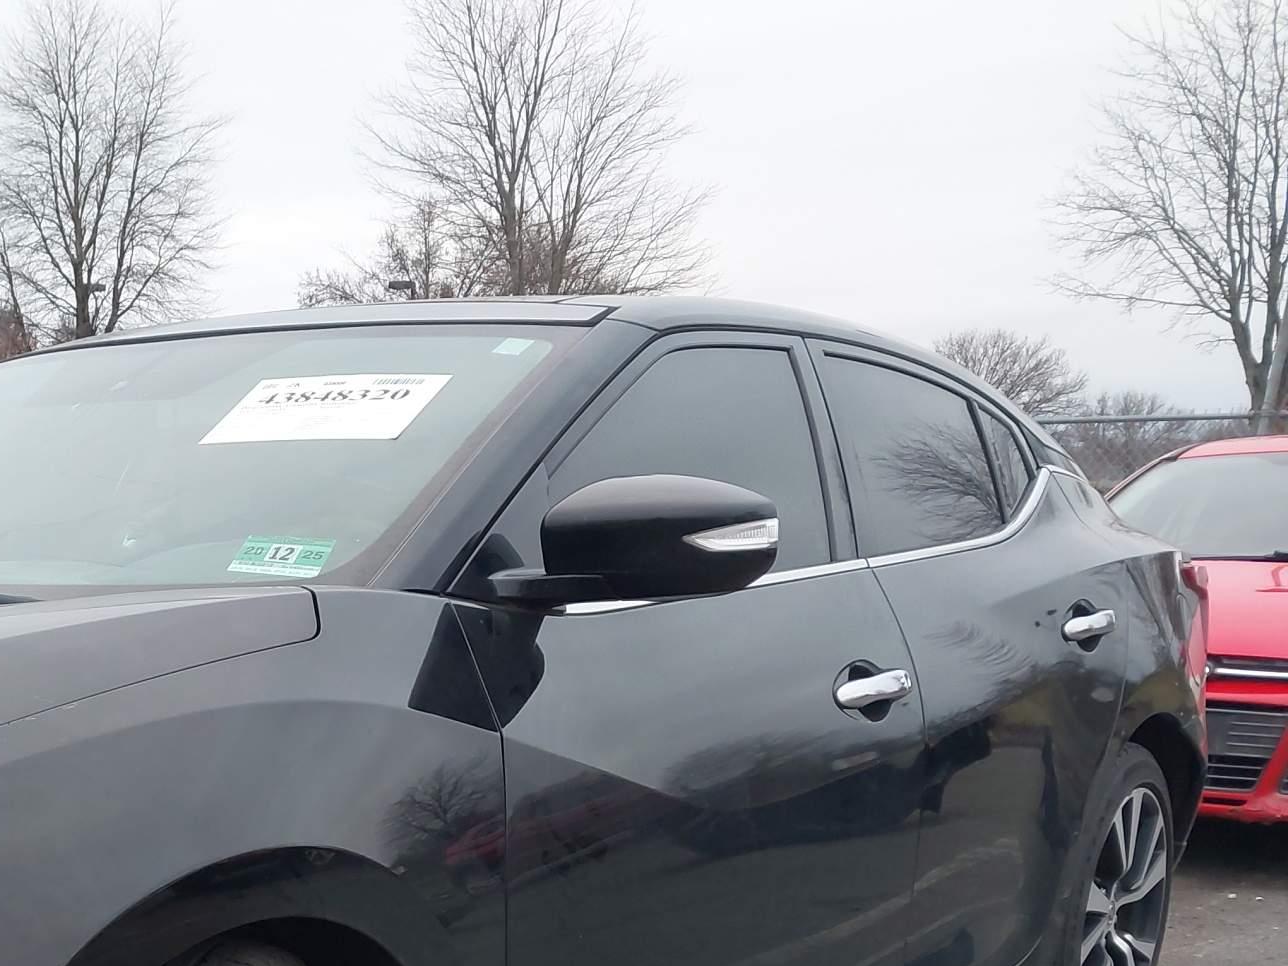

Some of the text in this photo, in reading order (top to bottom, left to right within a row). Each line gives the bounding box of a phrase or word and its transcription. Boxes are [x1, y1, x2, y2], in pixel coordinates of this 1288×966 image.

[259, 388, 410, 404] 43848320
[244, 545, 325, 561] 20 12 25
